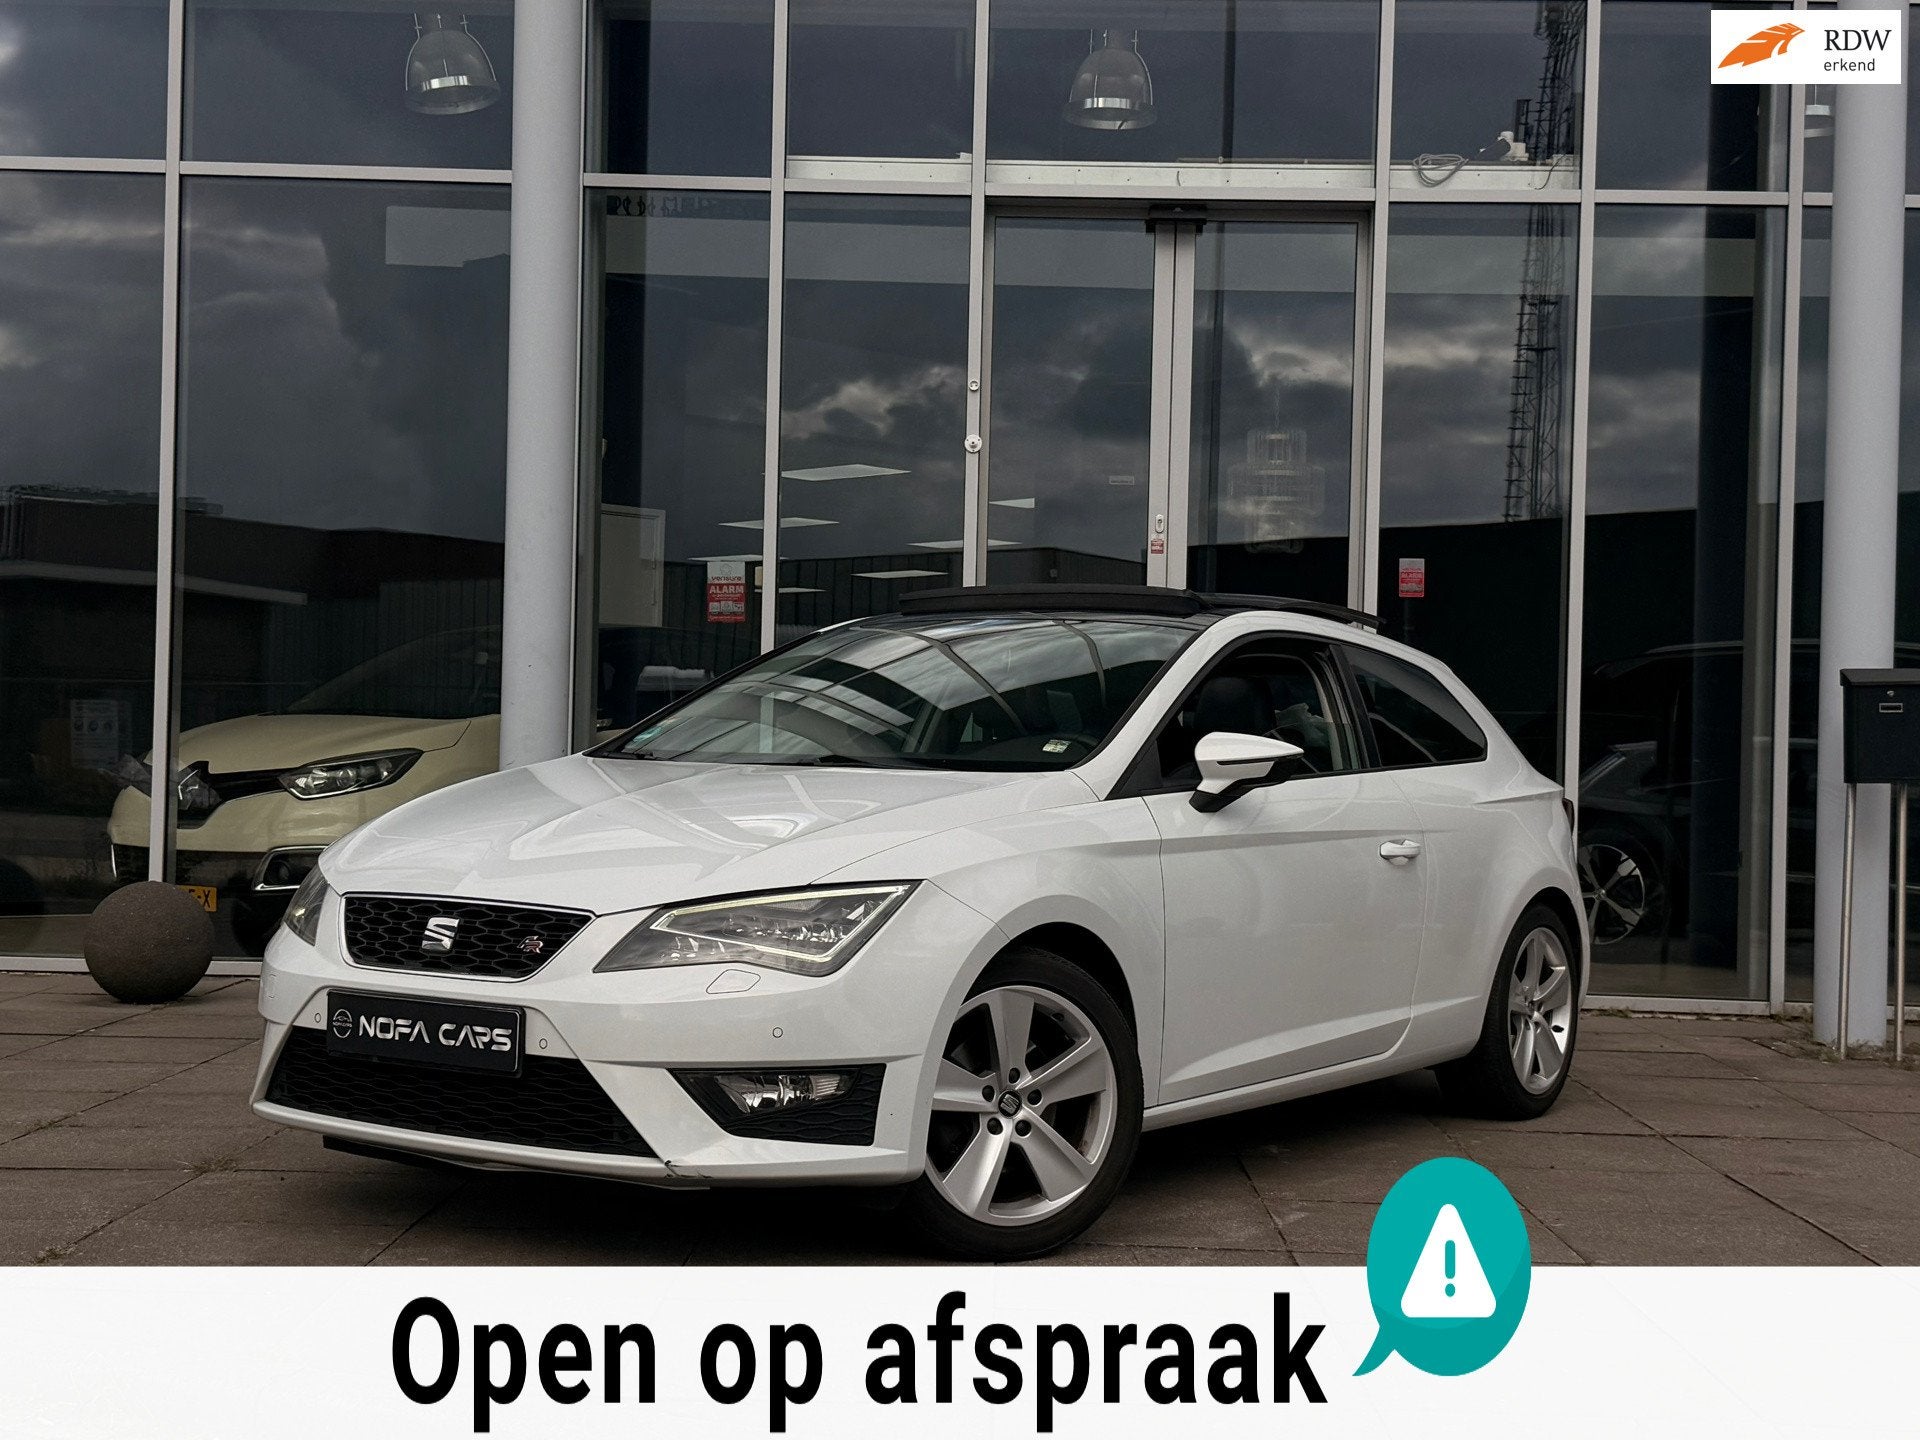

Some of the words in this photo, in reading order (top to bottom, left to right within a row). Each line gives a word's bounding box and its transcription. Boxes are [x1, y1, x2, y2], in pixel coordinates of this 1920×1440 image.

[710, 585, 744, 594] ALARM
[359, 1015, 430, 1043] NOFA
[438, 1023, 512, 1051] CARS
